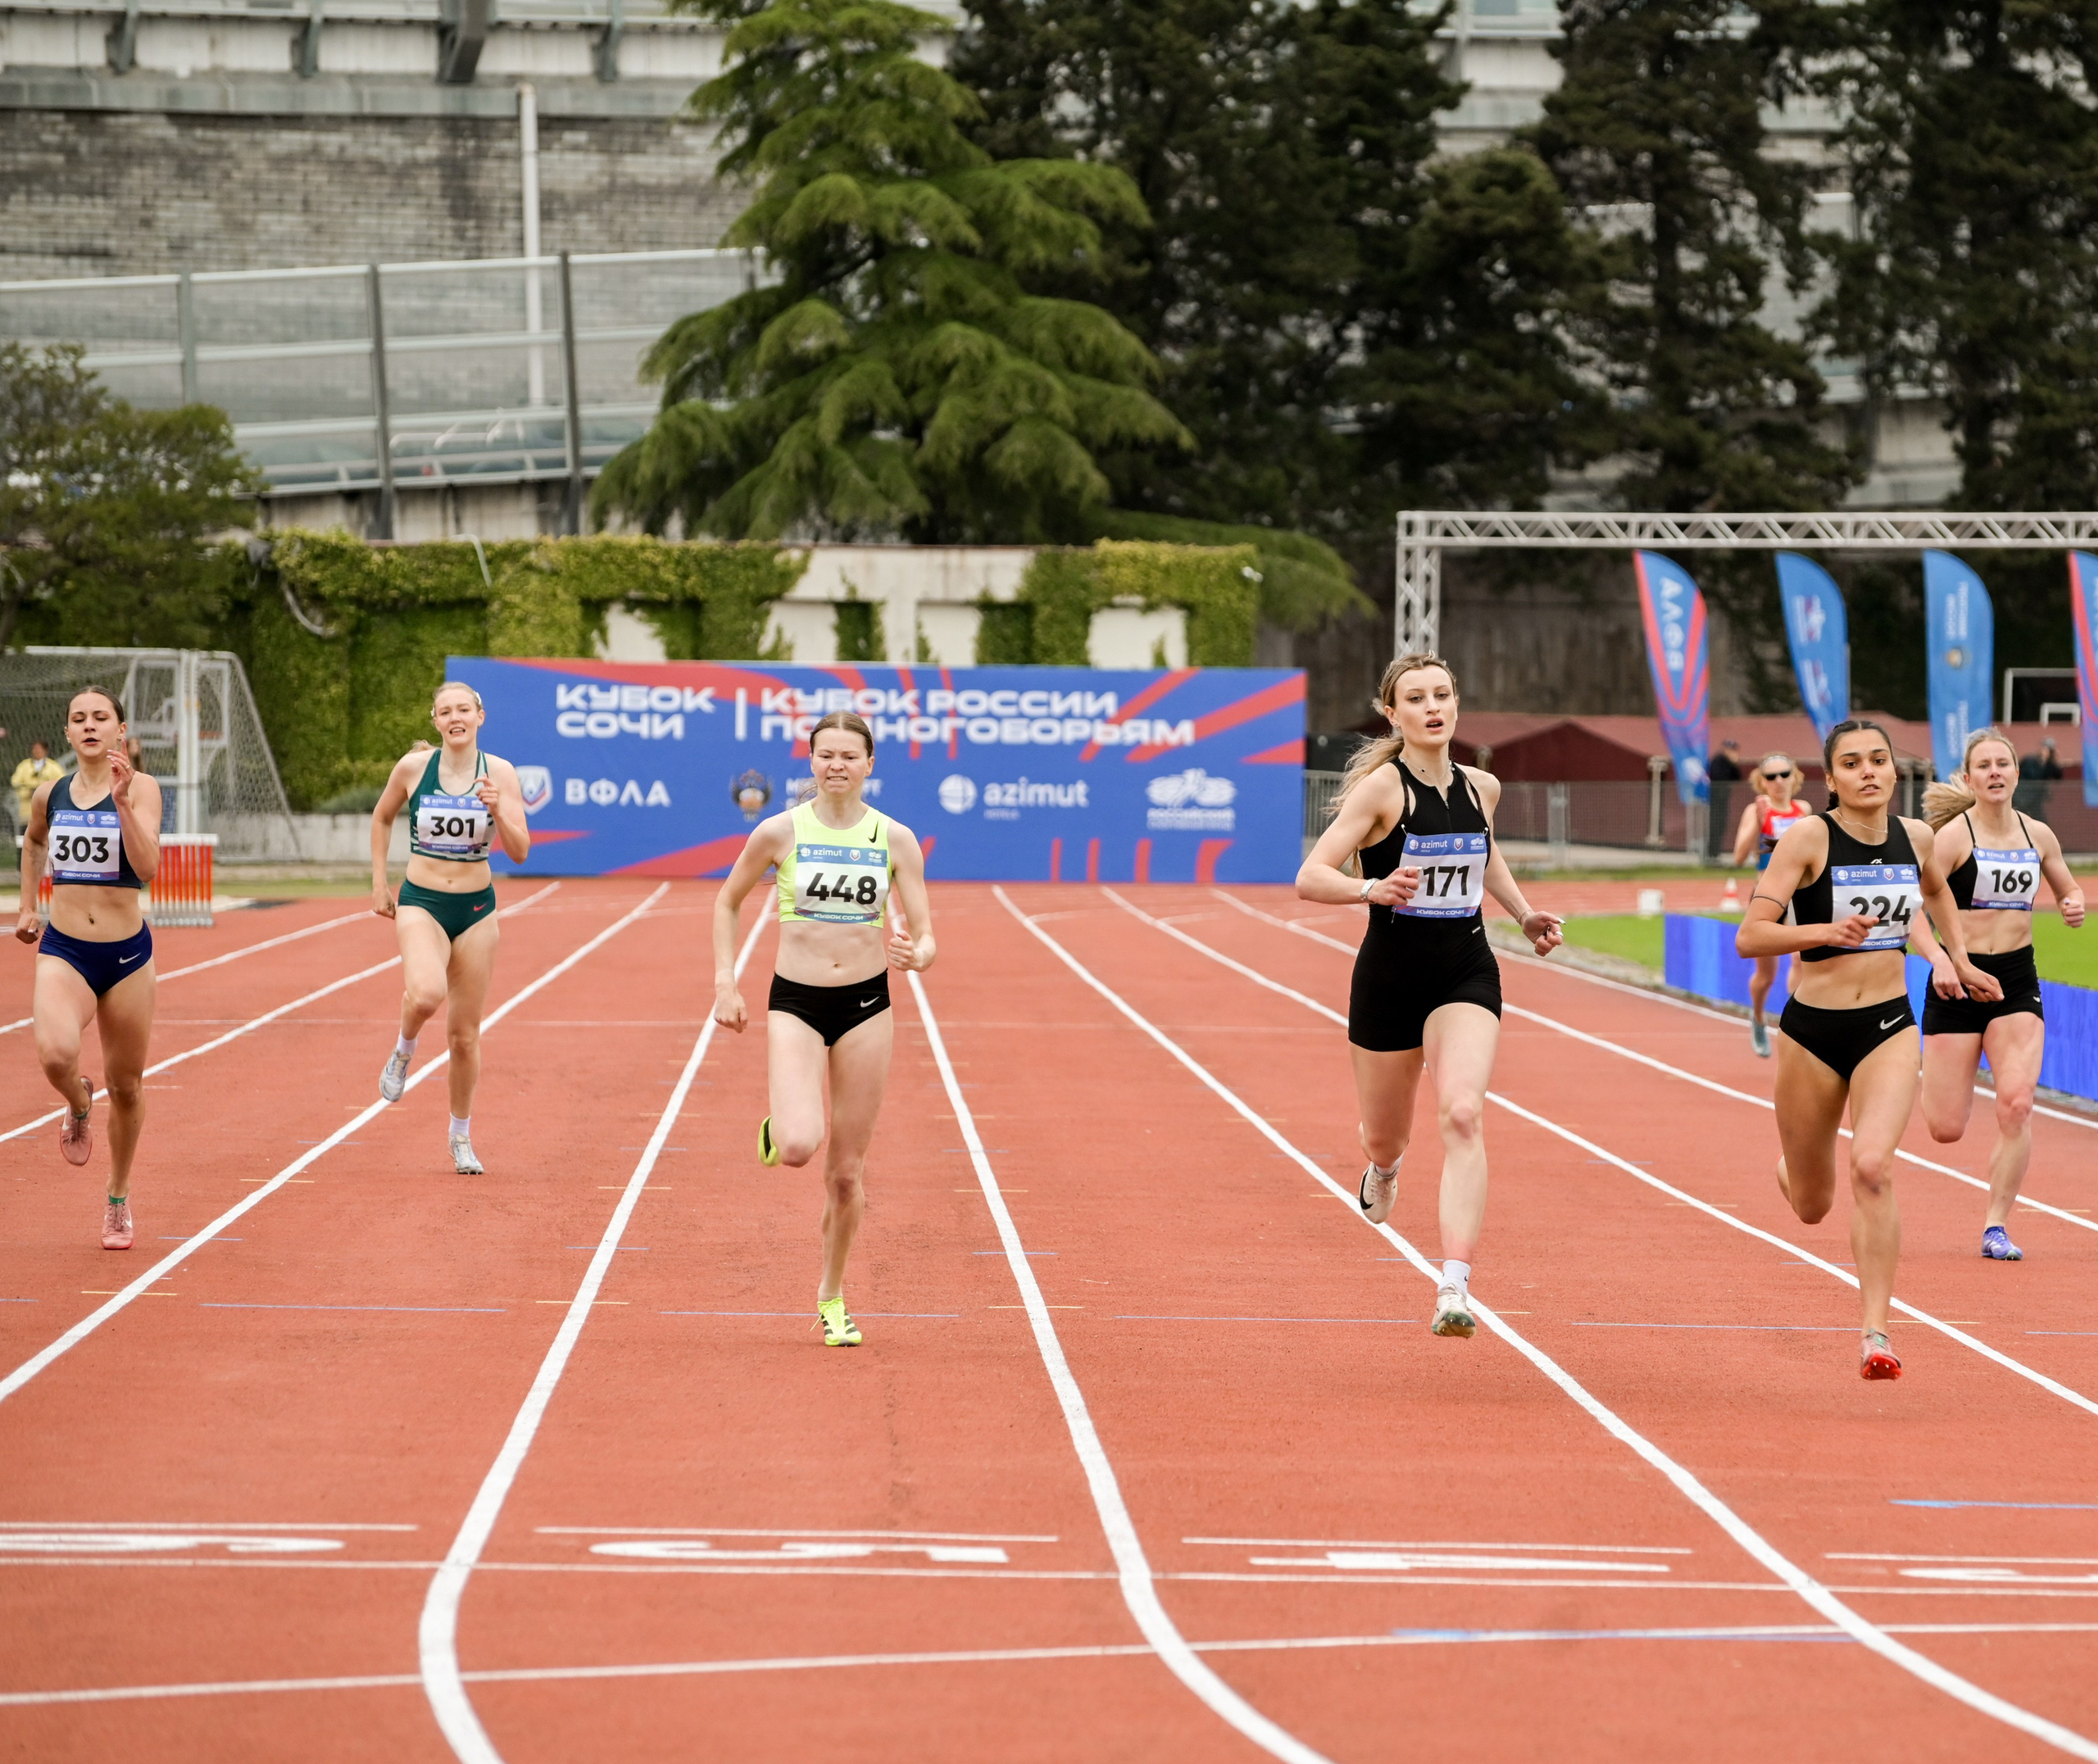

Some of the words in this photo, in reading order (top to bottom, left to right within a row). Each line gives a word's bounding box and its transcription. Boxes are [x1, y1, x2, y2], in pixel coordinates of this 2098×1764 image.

[556, 683, 715, 714] КУБОК
[761, 687, 920, 715] КУБОК
[927, 689, 1118, 718] РОССИИ
[556, 712, 685, 740] СОЧИ
[866, 716, 1195, 746] НОГОБОРЬЯМ
[565, 778, 671, 807] ВФЛА
[983, 776, 1089, 808] azimut
[61, 813, 84, 821] azimut
[430, 816, 475, 838] 301
[54, 835, 109, 864] 303
[813, 847, 842, 857] azimut
[1421, 840, 1448, 849] azimut
[1423, 865, 1470, 897] 171
[1851, 869, 1878, 877] azimut
[1991, 869, 2033, 893] 169
[806, 873, 877, 905] 448
[1849, 895, 1911, 927] 224
